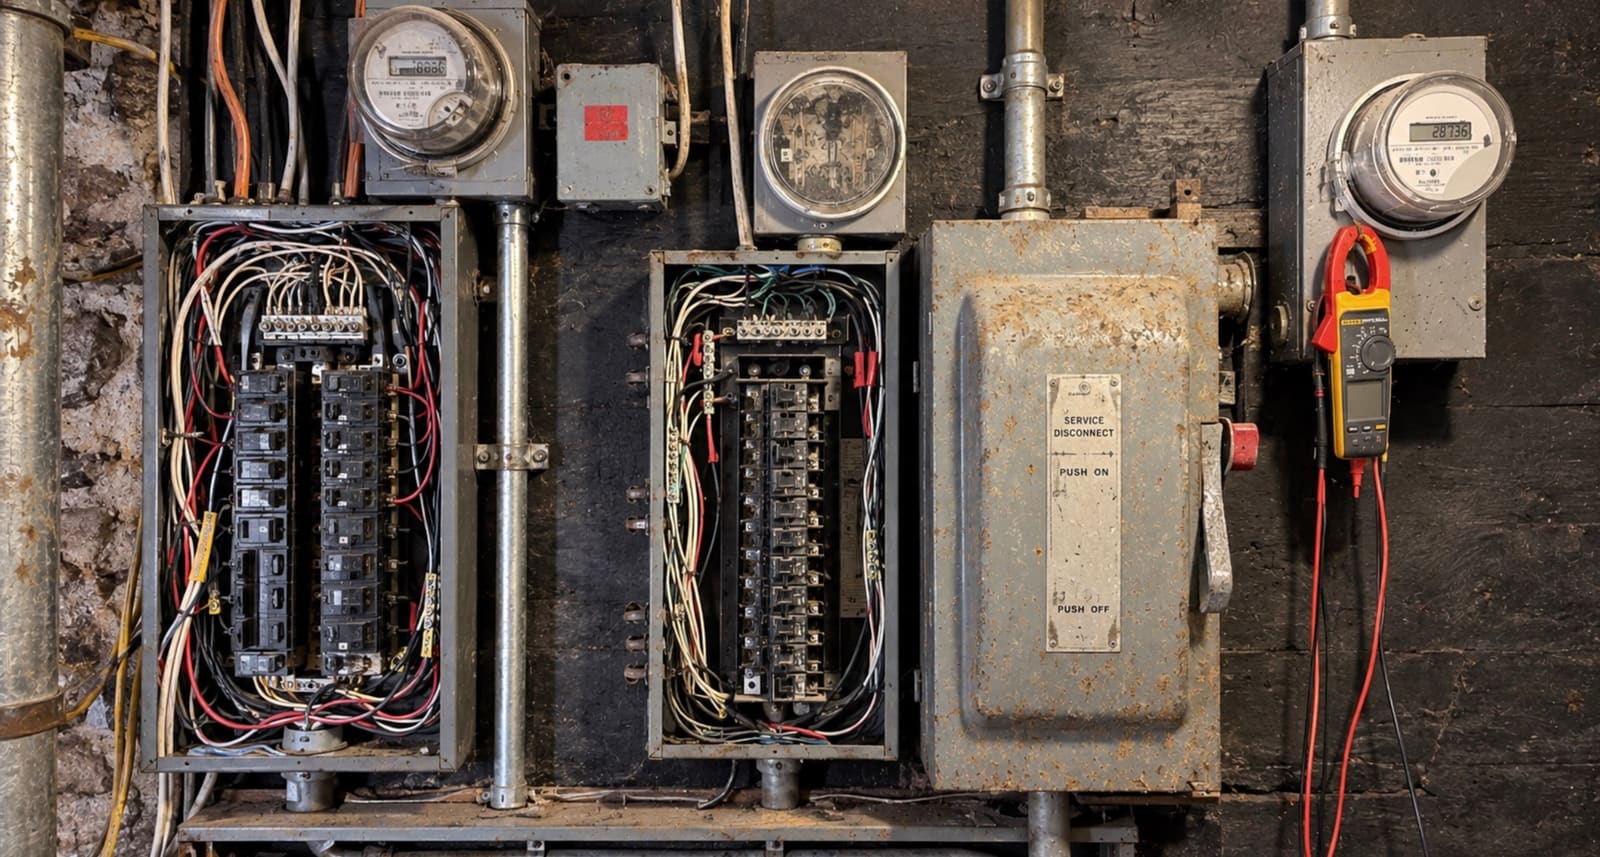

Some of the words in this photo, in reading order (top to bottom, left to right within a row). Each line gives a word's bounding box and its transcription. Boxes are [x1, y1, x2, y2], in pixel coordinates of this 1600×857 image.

[1432, 125, 1468, 138] 28736
[1064, 416, 1105, 425] SERVICE
[1054, 429, 1114, 437] DISCONNECT
[1060, 468, 1088, 476] PUSH
[1094, 468, 1109, 476] ON
[1058, 605, 1085, 613] PUSH
[1091, 605, 1109, 613] OFF
